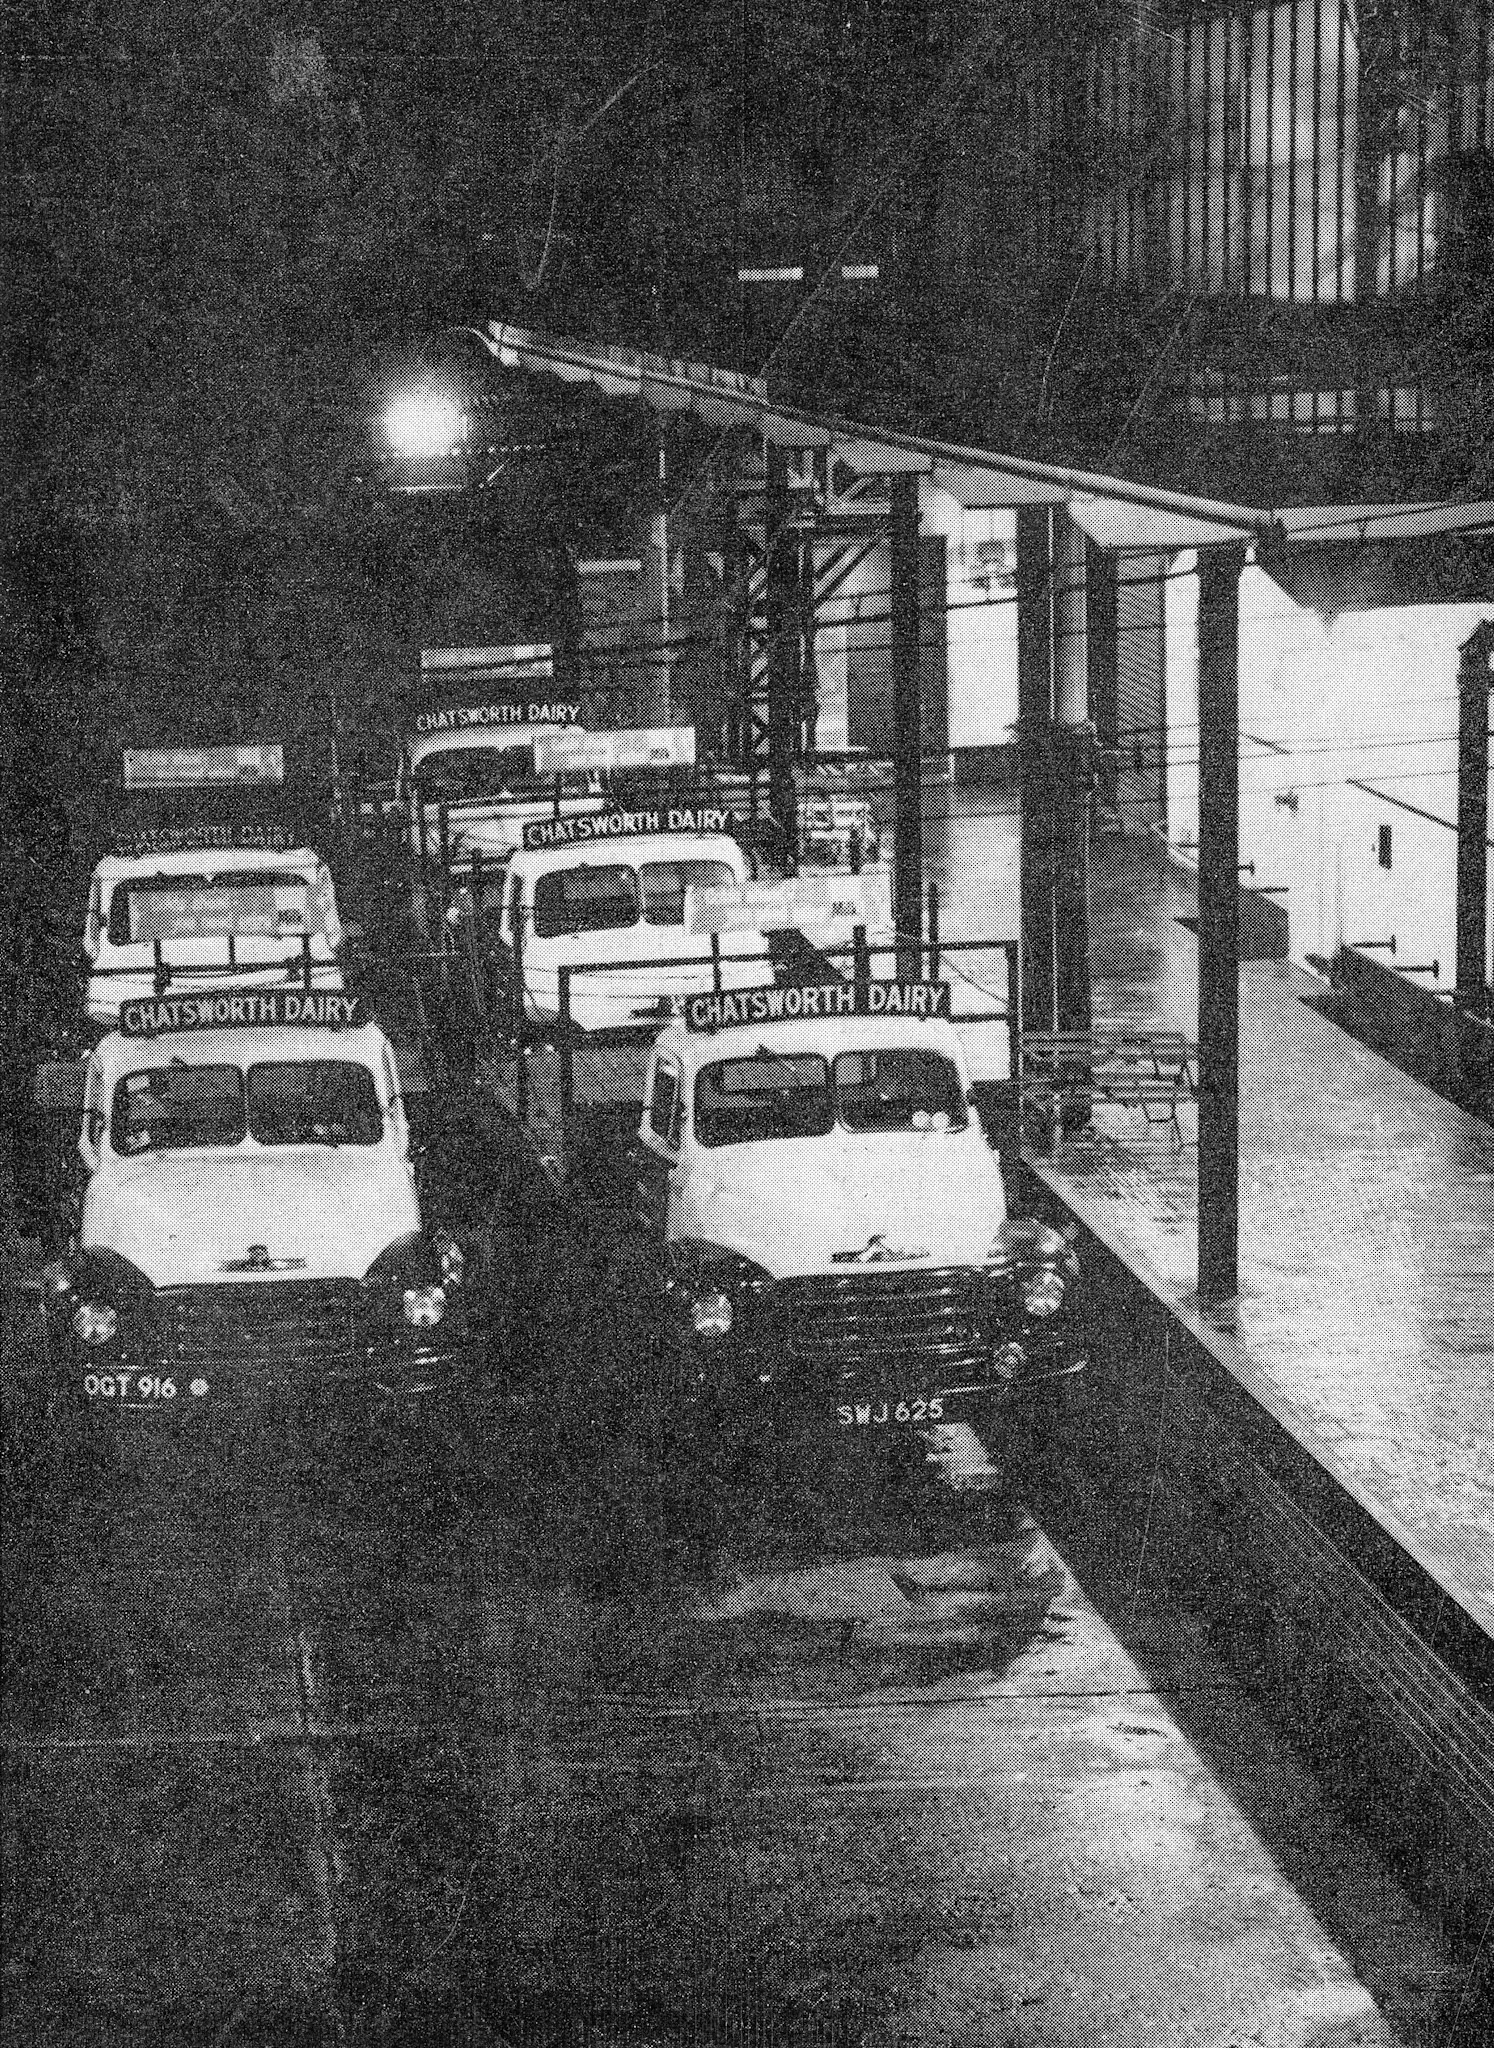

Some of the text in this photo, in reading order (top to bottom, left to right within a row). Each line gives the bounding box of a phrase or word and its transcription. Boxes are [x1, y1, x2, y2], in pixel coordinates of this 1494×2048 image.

[416, 703, 580, 731] CHATSWORTH DAIRY
[527, 809, 729, 845] CHATSWORTH DAIRY
[125, 996, 358, 1031] CHATSWORTH DAIRY
[691, 984, 943, 1026] CHATSWORTH DAIRY
[84, 1373, 178, 1399] OGT 916
[837, 1398, 943, 1425] SWJ 625
